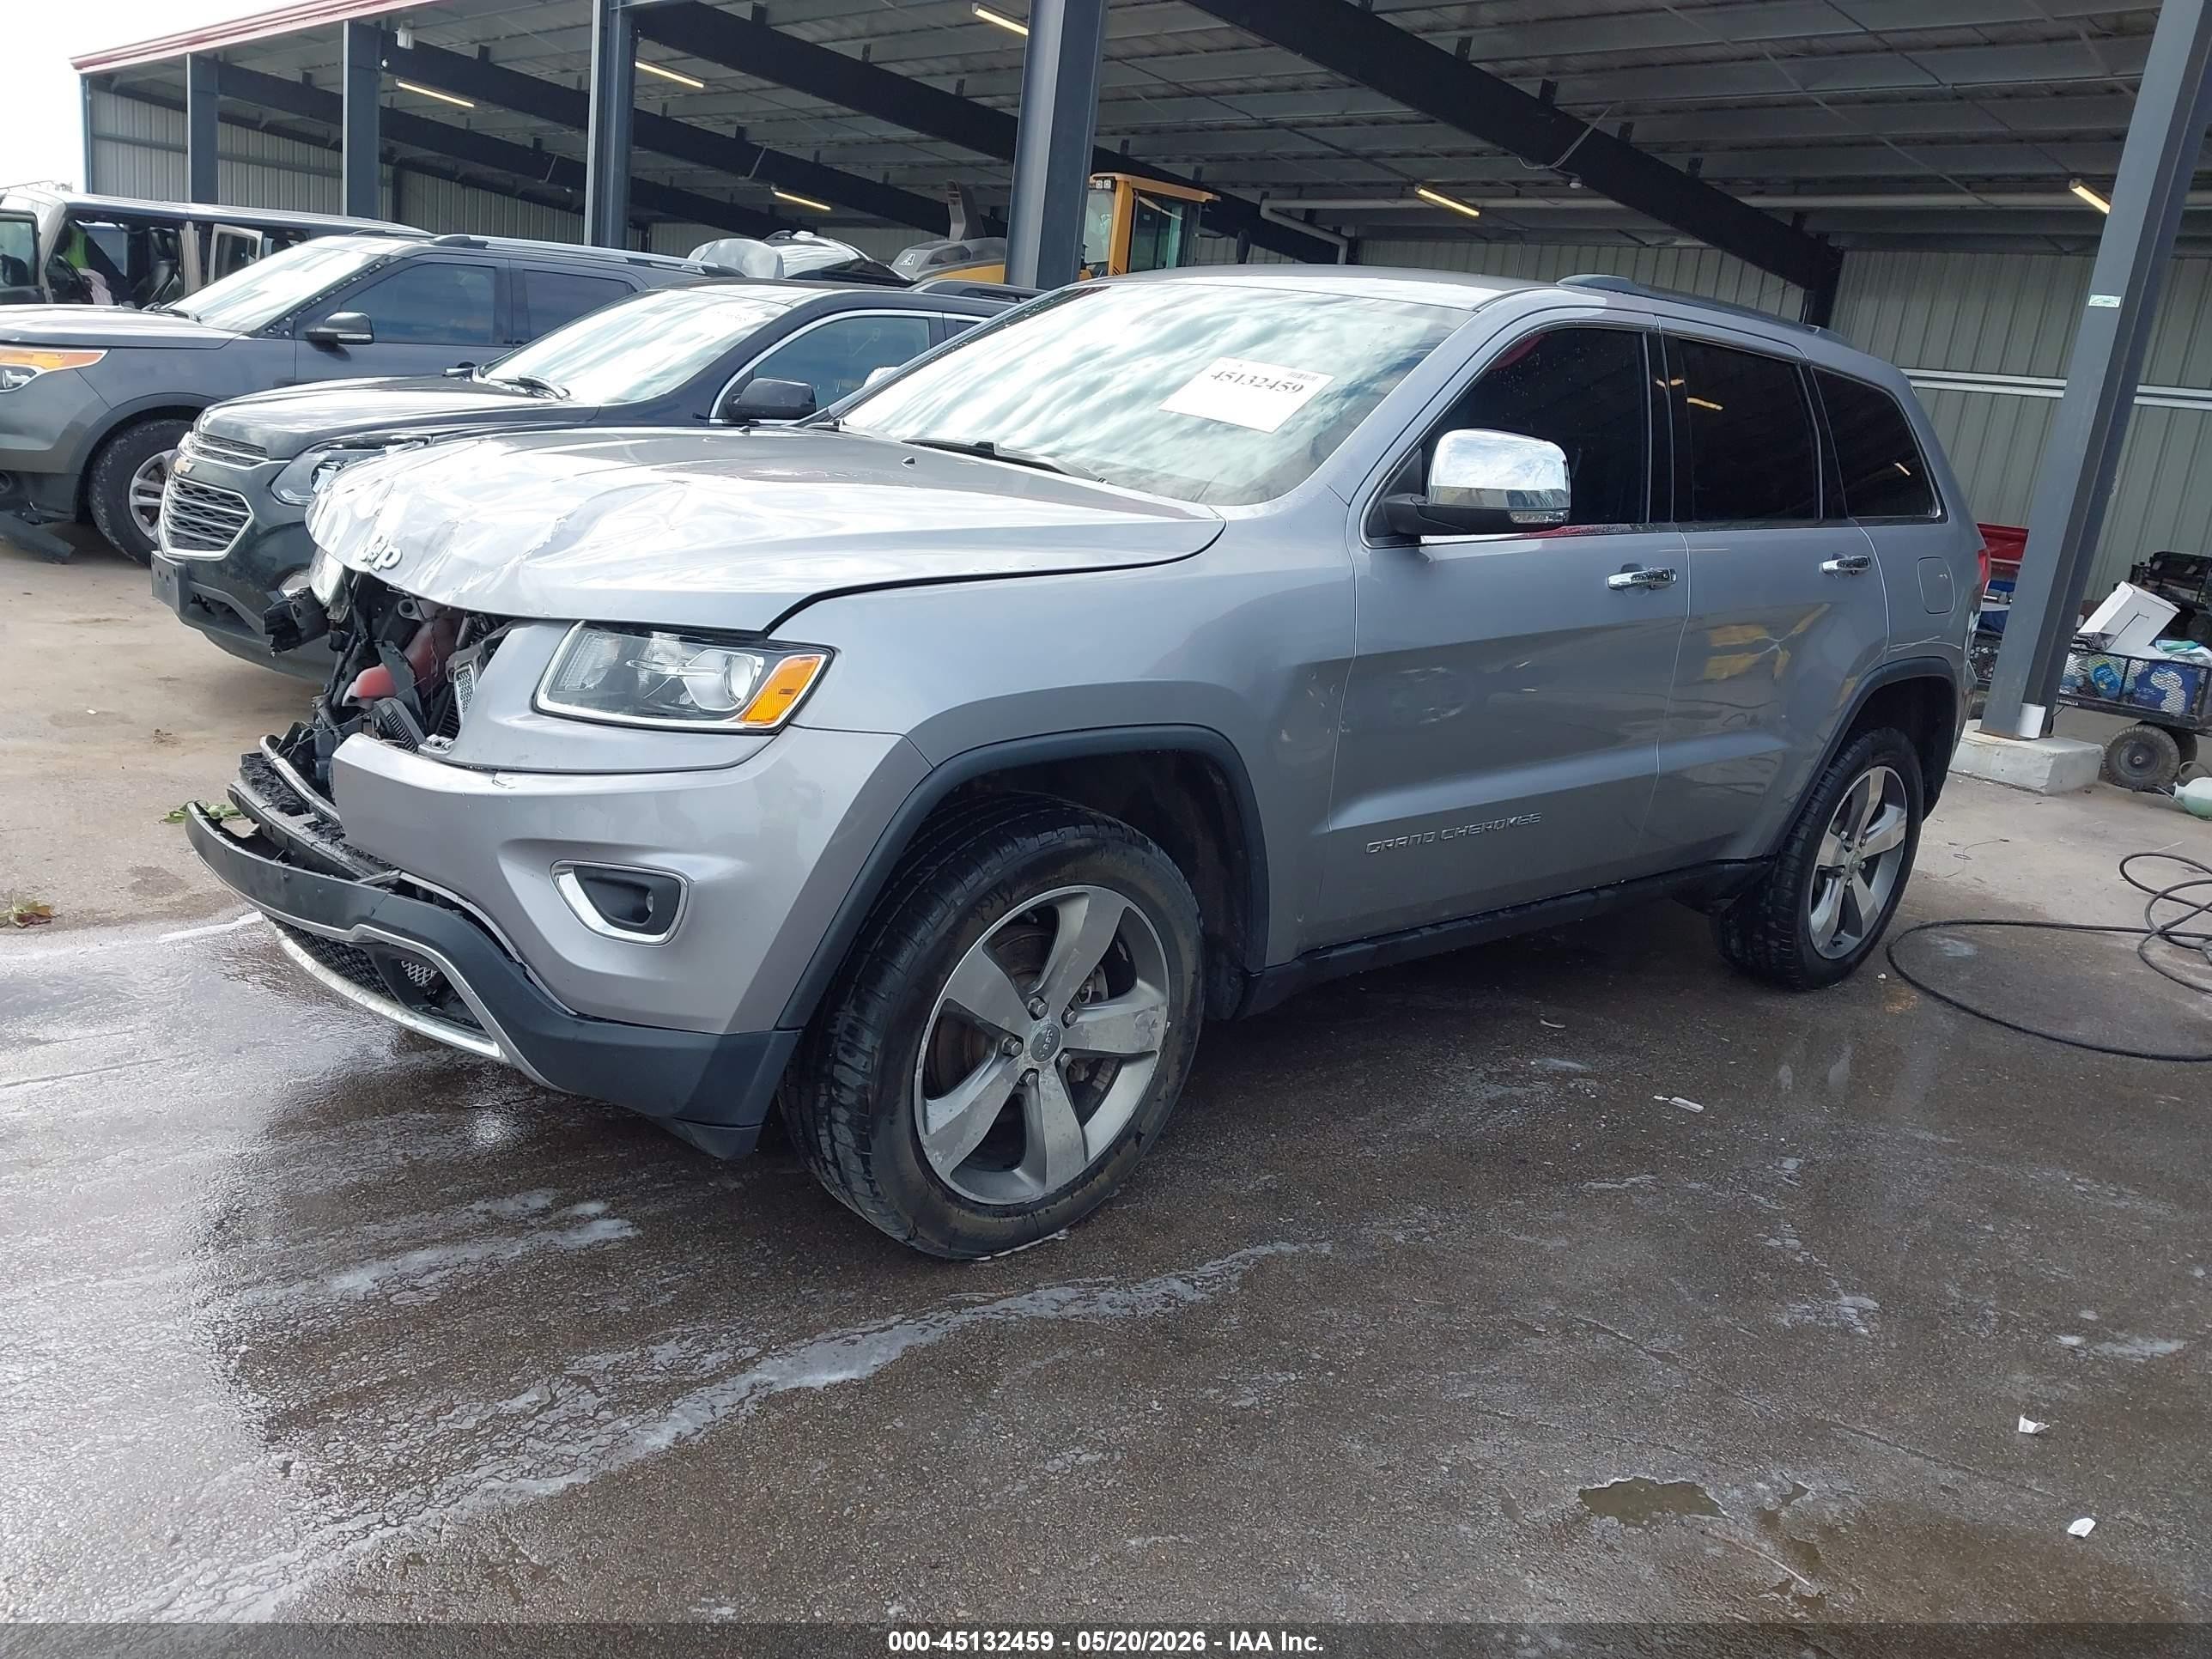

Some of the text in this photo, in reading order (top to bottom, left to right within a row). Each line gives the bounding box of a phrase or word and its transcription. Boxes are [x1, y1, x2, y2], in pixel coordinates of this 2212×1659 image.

[1211, 370, 1305, 394] 45132459
[1365, 812, 1542, 854] GRAND CHEROKEE
